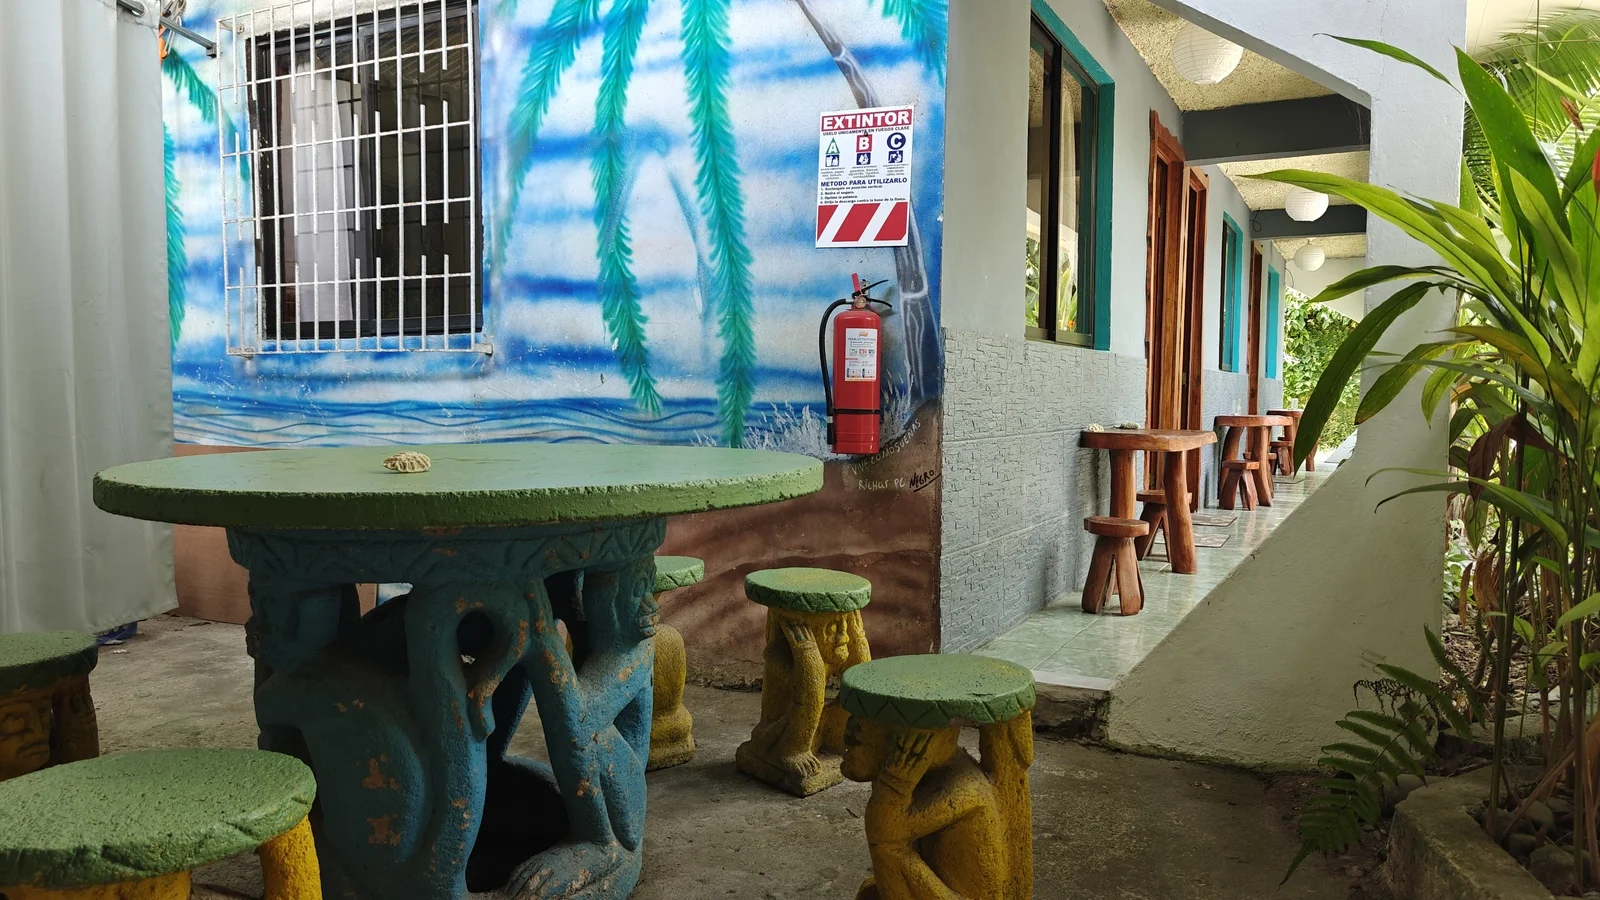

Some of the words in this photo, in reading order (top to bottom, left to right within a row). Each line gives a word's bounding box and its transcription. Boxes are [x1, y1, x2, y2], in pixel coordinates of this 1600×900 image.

[823, 111, 910, 130] EXTINTOR
[827, 141, 839, 154] A
[859, 136, 869, 151] B
[890, 134, 902, 149] C
[868, 177, 908, 185] UTILIZARLO
[870, 446, 895, 465] COMO
[909, 470, 935, 489] NEGRO
